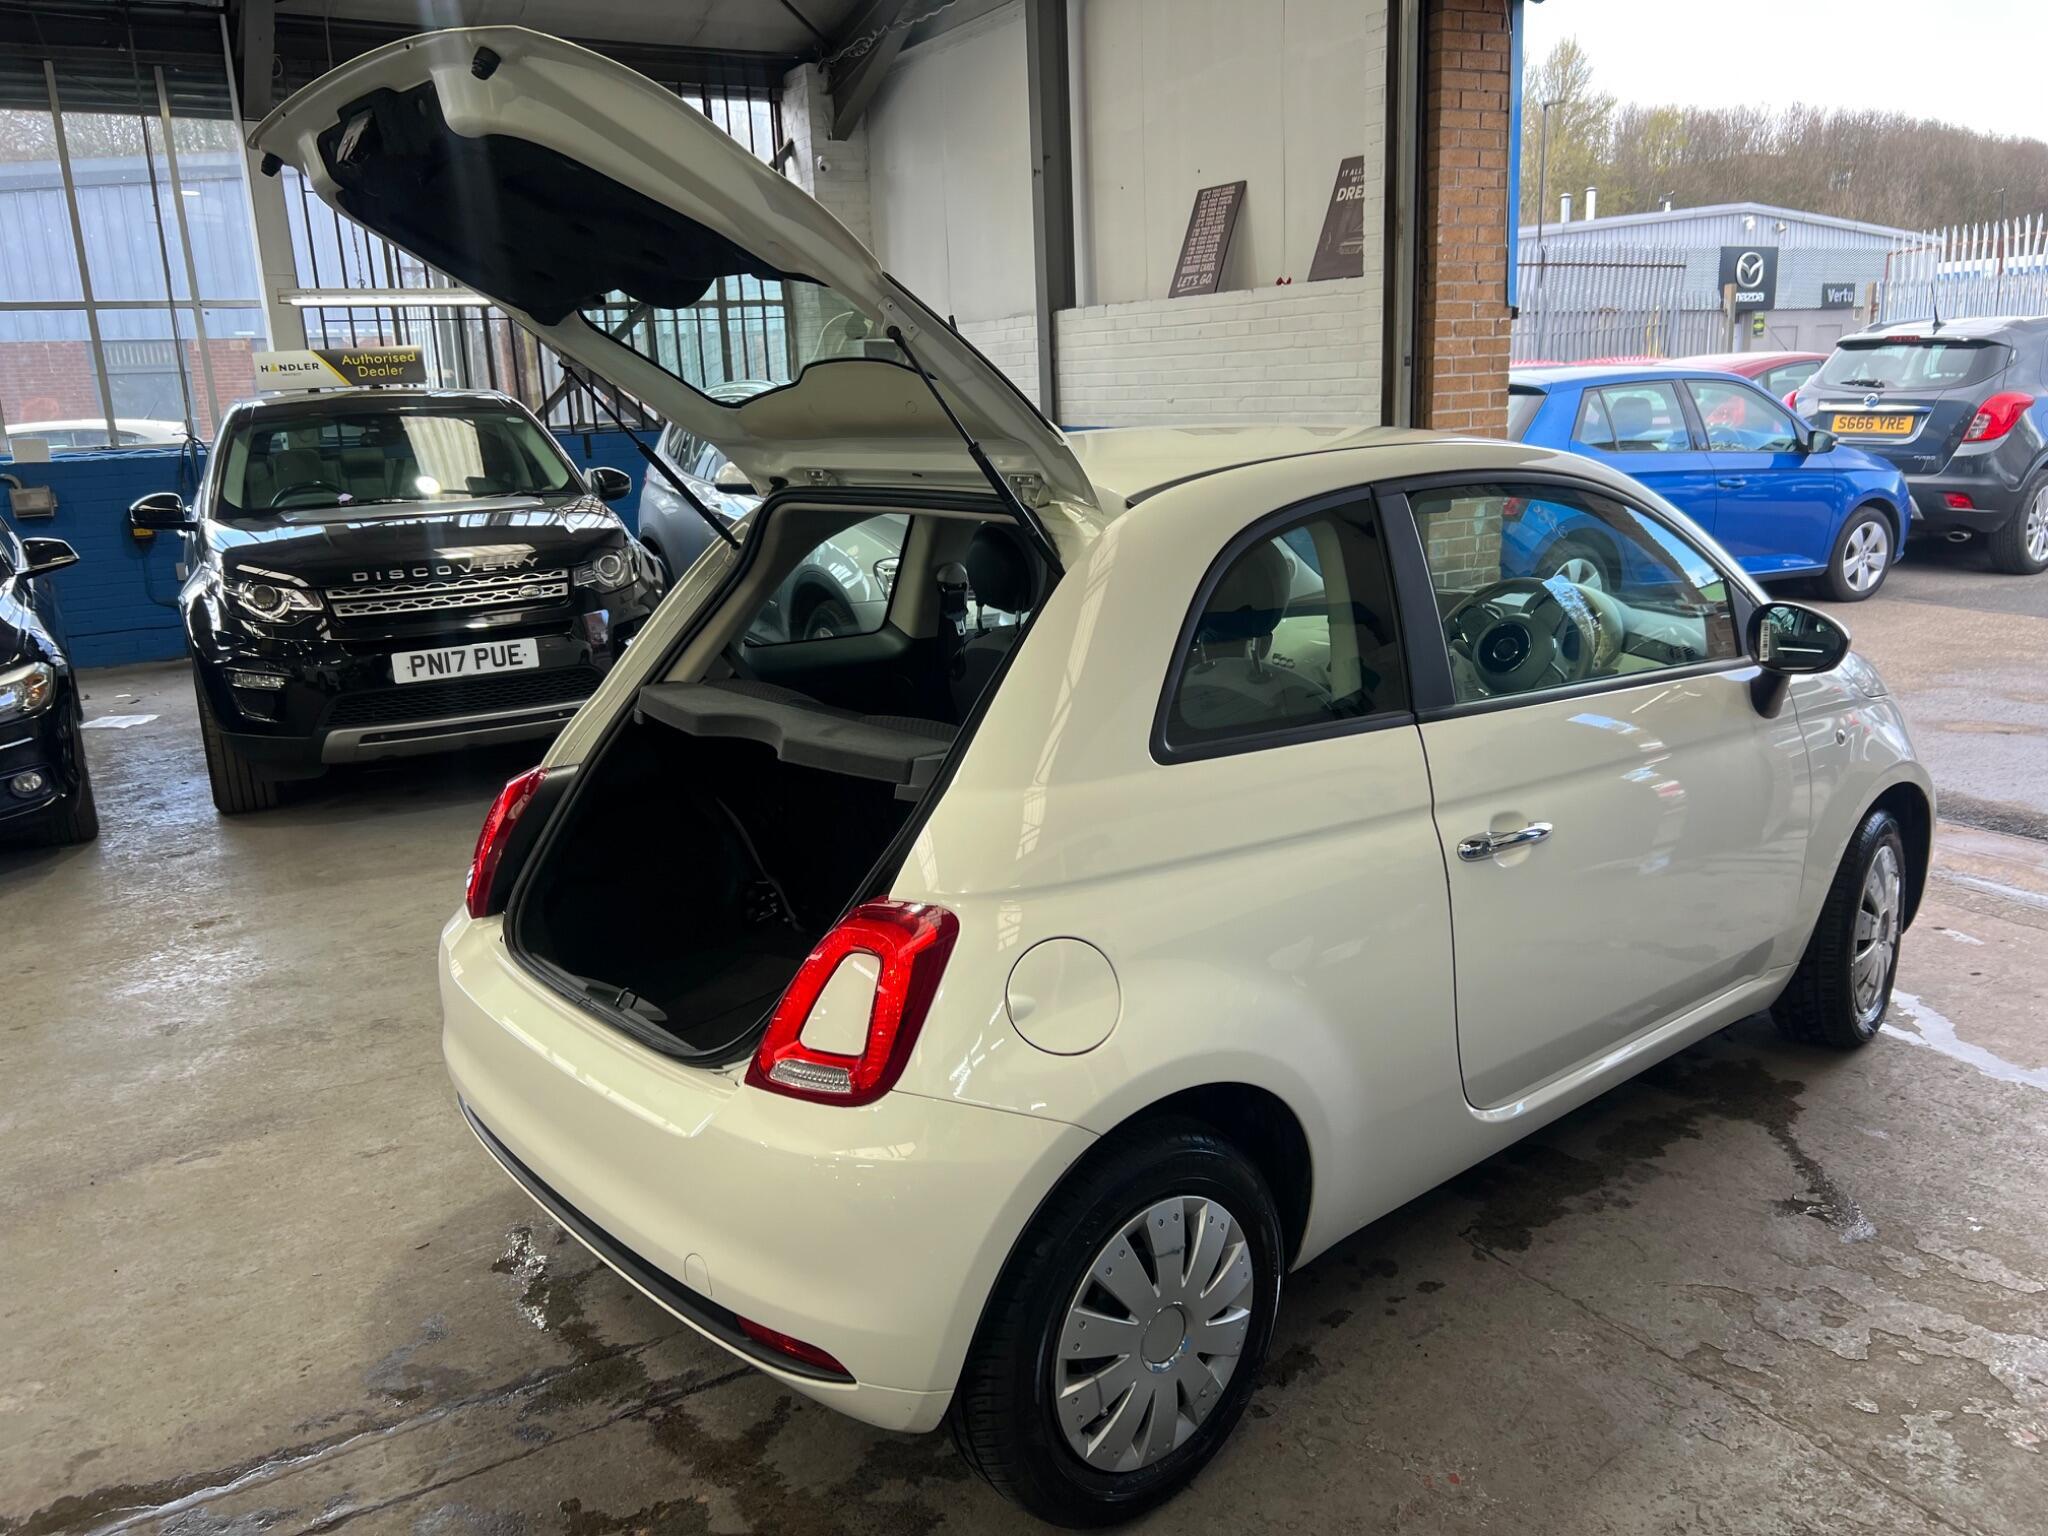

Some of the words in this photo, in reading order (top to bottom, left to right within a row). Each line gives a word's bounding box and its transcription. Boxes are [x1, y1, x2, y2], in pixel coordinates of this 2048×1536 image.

[1200, 273, 1213, 284] GO
[1827, 288, 1854, 303] Vertu
[341, 352, 417, 366] Authorised
[357, 365, 405, 378] Dealer
[1838, 415, 1874, 430] SG66
[1879, 415, 1905, 430] YRE
[351, 557, 539, 582] DISCOVERY
[409, 650, 466, 678] PN17
[473, 643, 523, 670] PUE
